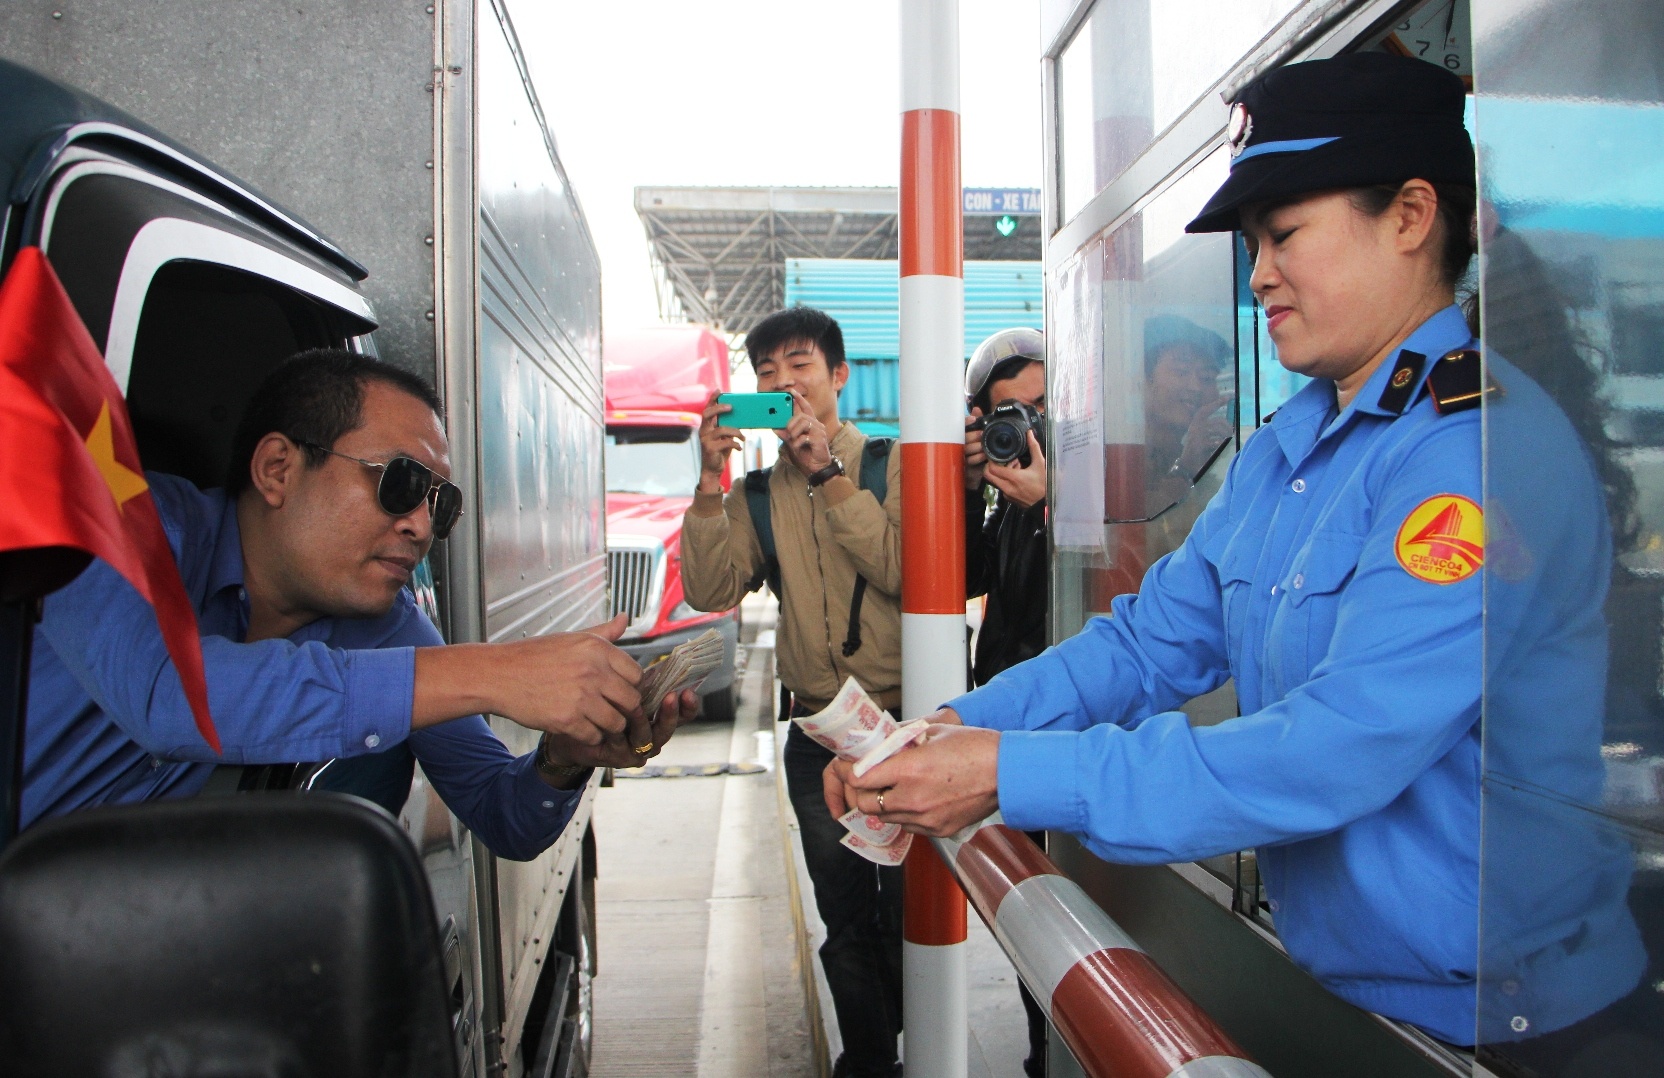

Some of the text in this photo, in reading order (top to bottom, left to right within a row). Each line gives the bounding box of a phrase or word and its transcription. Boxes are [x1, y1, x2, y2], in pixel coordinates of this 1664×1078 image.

[1416, 40, 1430, 56] 7
[1443, 53, 1461, 70] 6
[965, 192, 992, 211] CON
[1002, 192, 1020, 211] XE
[1410, 554, 1463, 571] CIENCO4
